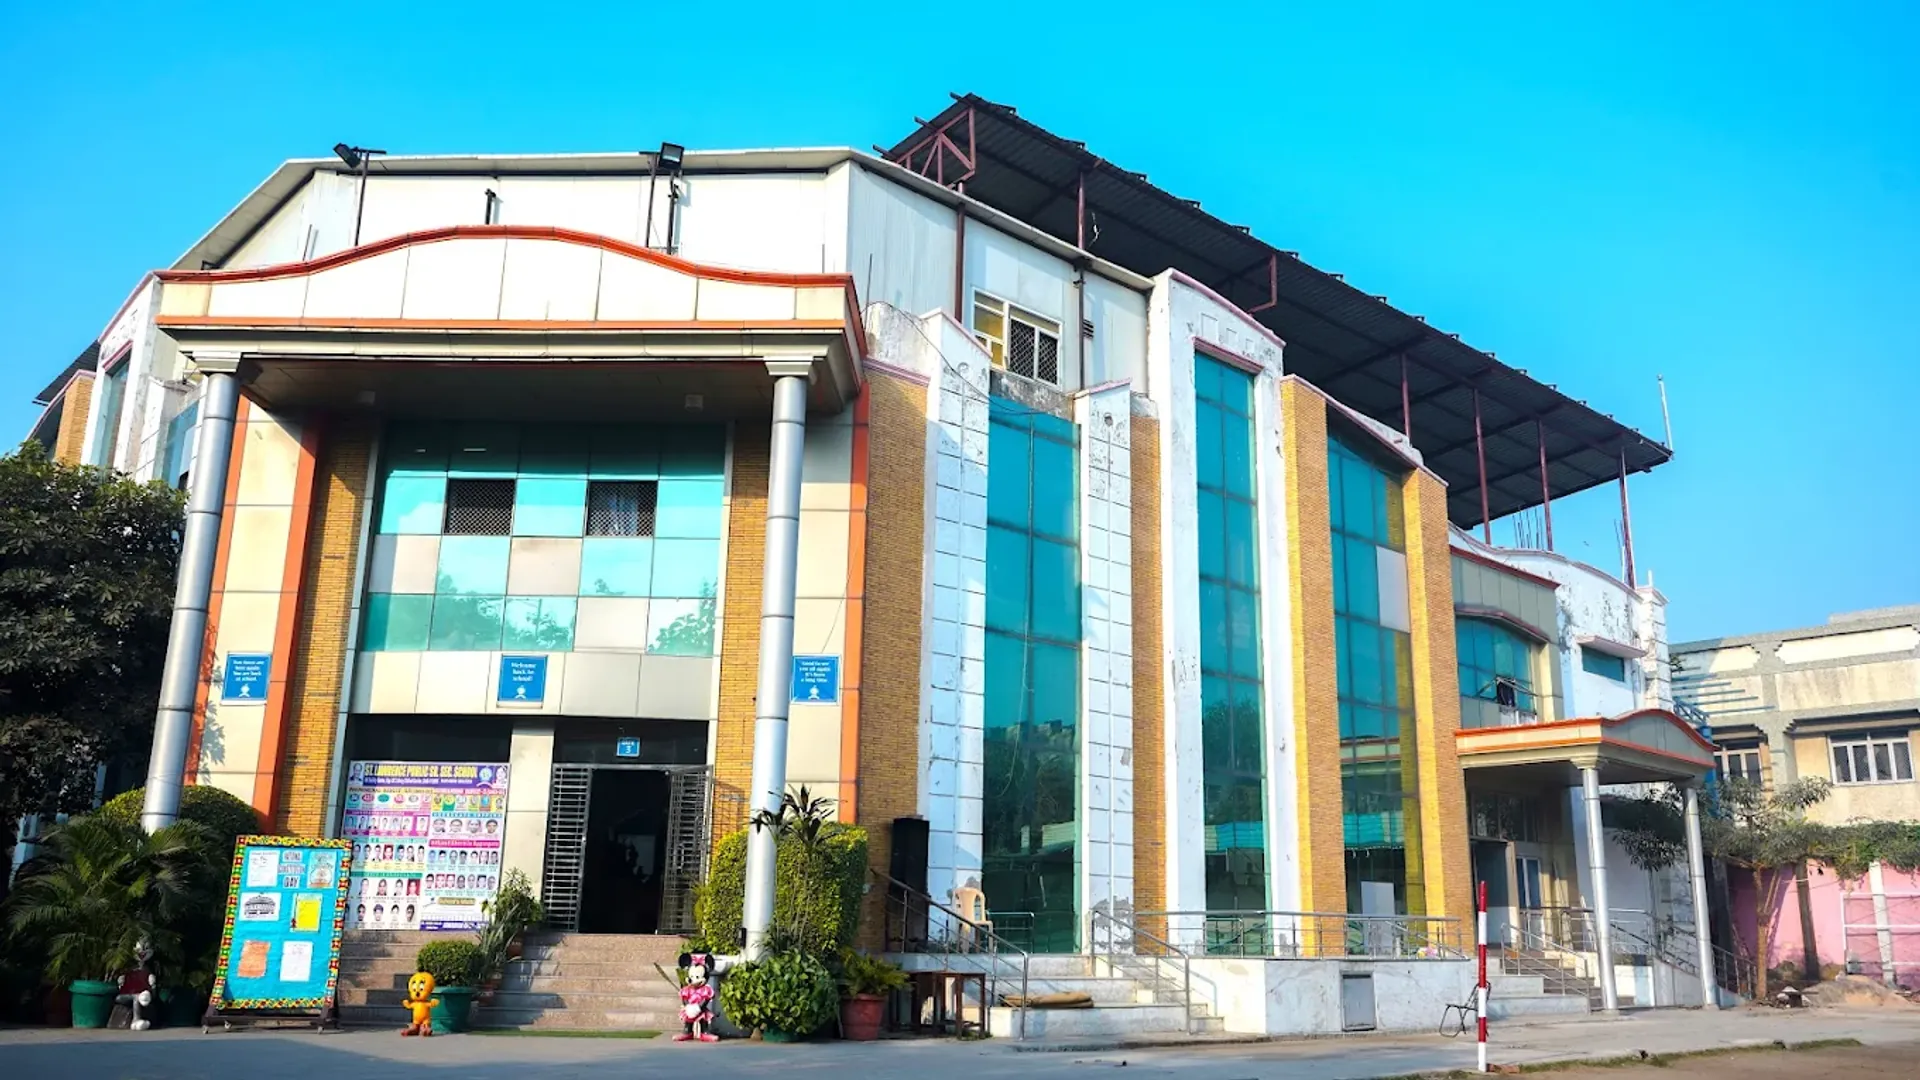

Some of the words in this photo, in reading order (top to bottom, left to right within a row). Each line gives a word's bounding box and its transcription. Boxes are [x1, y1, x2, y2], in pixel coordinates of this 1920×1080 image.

[512, 667, 526, 675] back
[453, 765, 477, 778] SCHOOL
[284, 876, 298, 888] DAY
